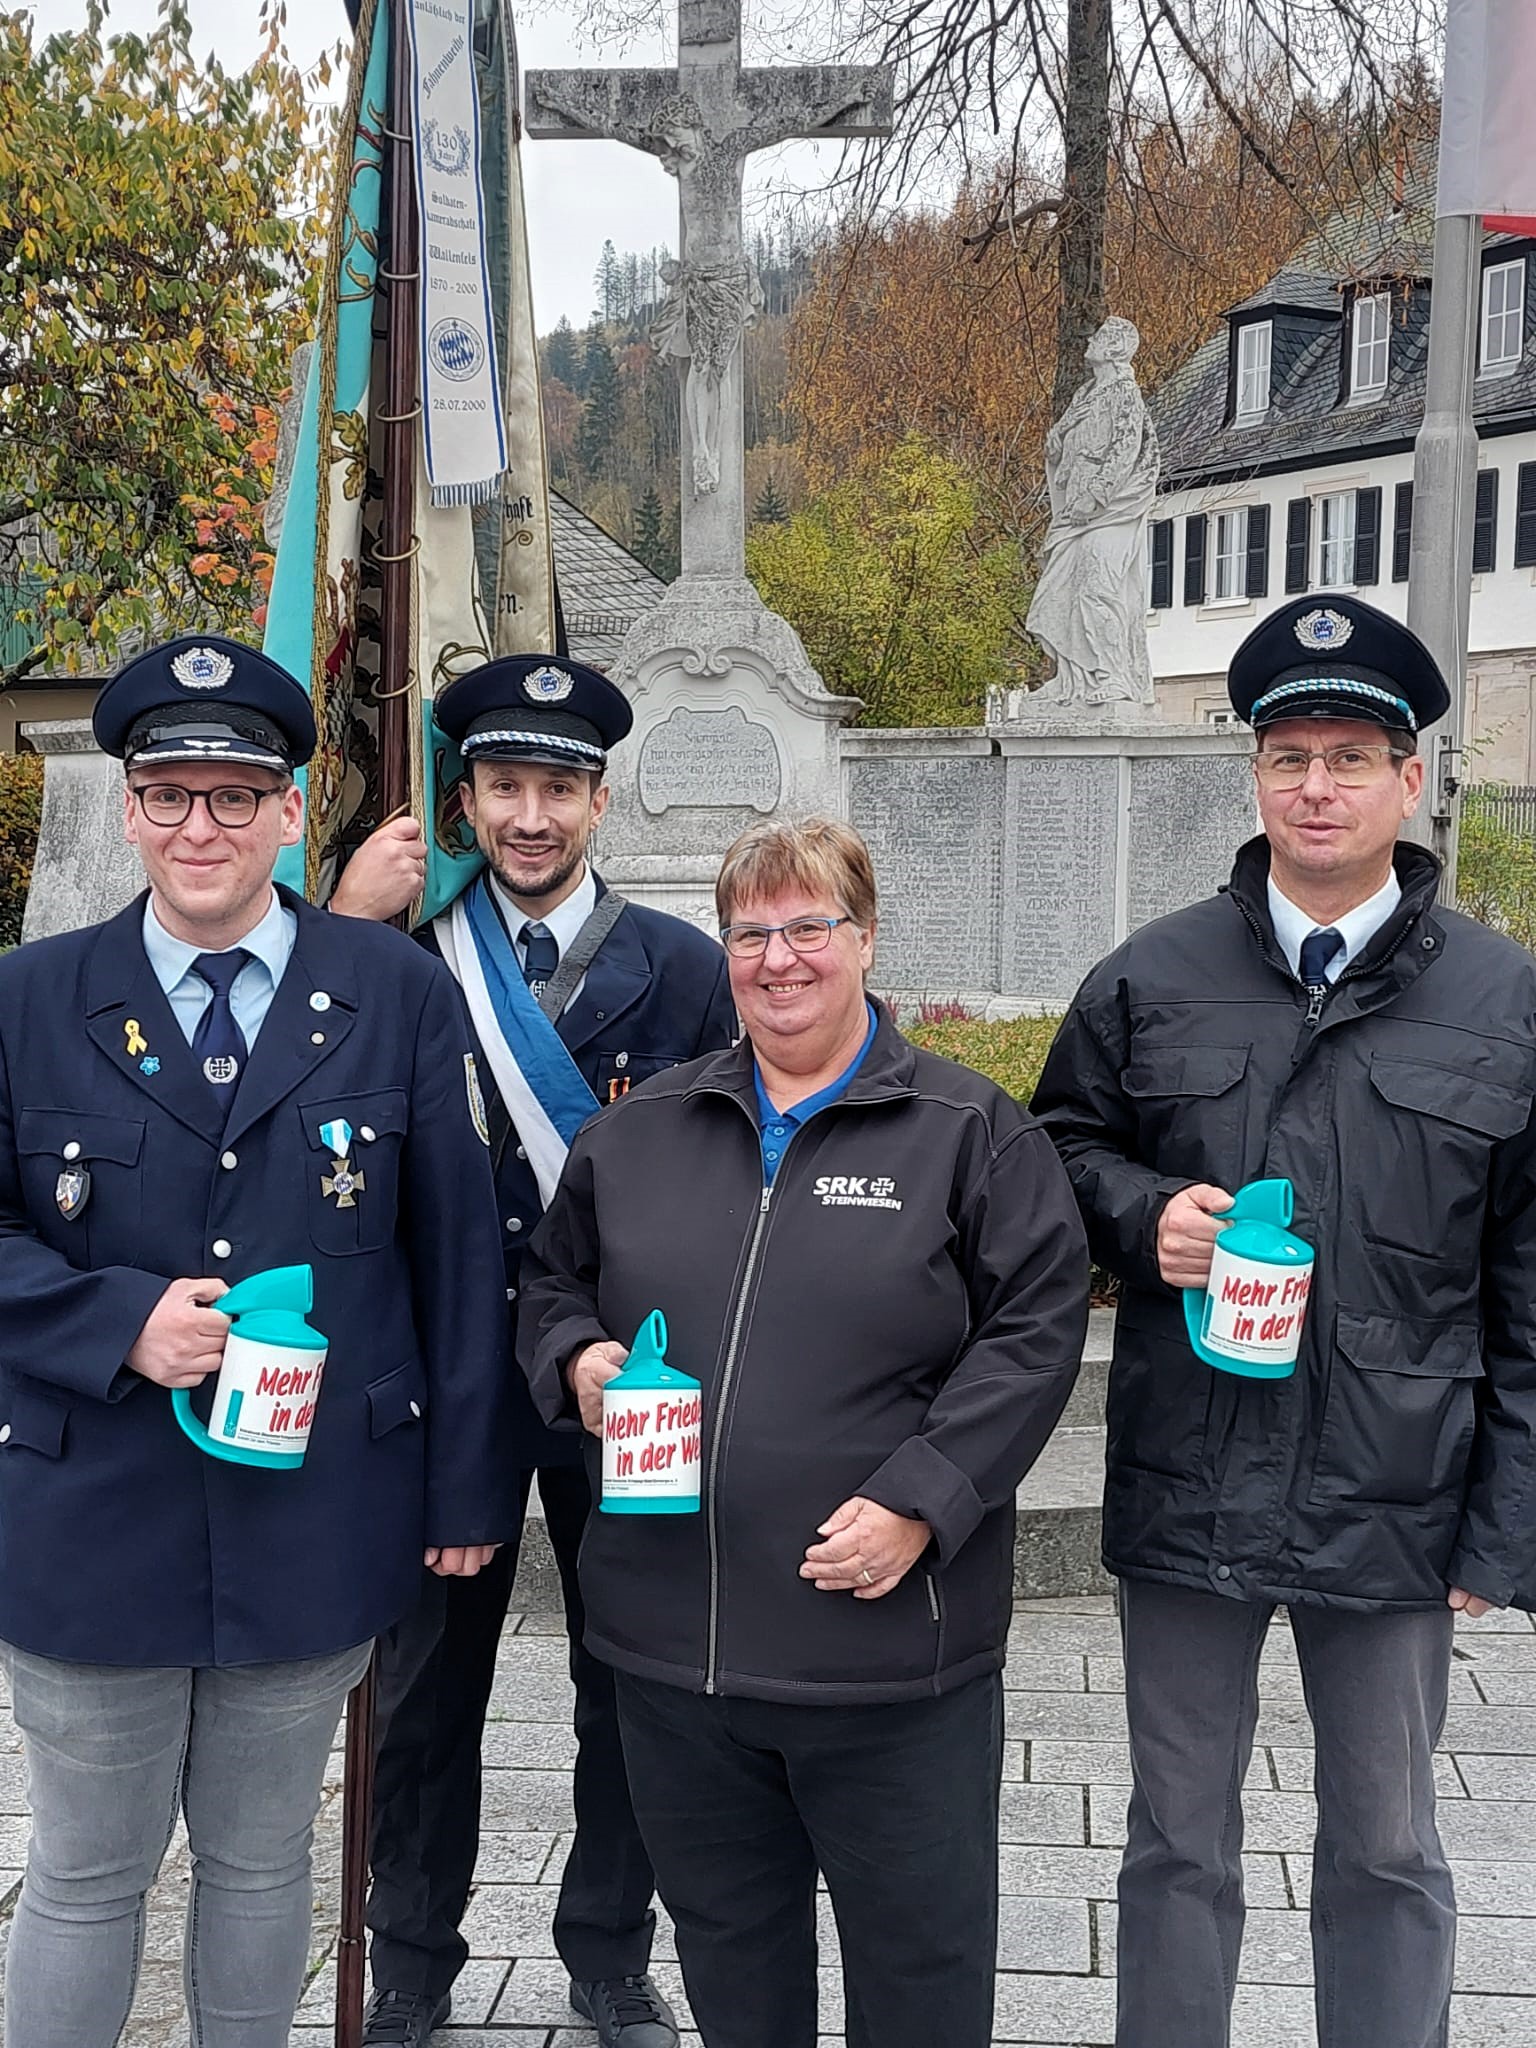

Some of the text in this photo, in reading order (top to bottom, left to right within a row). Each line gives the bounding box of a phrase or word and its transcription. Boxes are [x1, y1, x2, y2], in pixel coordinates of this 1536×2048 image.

[436, 131, 457, 150] 130
[429, 244, 477, 265] Wallenfels
[430, 276, 449, 291] 1870
[455, 282, 478, 294] 2000
[433, 398, 486, 411] 28.07.2000
[813, 1176, 868, 1195] SRK
[821, 1195, 902, 1211] STEINWIESEN
[1221, 1276, 1278, 1307] Mehr
[1233, 1310, 1254, 1340] in
[1260, 1313, 1295, 1341] der
[256, 1367, 312, 1396] Mehr
[268, 1401, 292, 1432] in
[606, 1408, 650, 1443] Mehr
[617, 1445, 634, 1477] in
[640, 1442, 677, 1473] der
